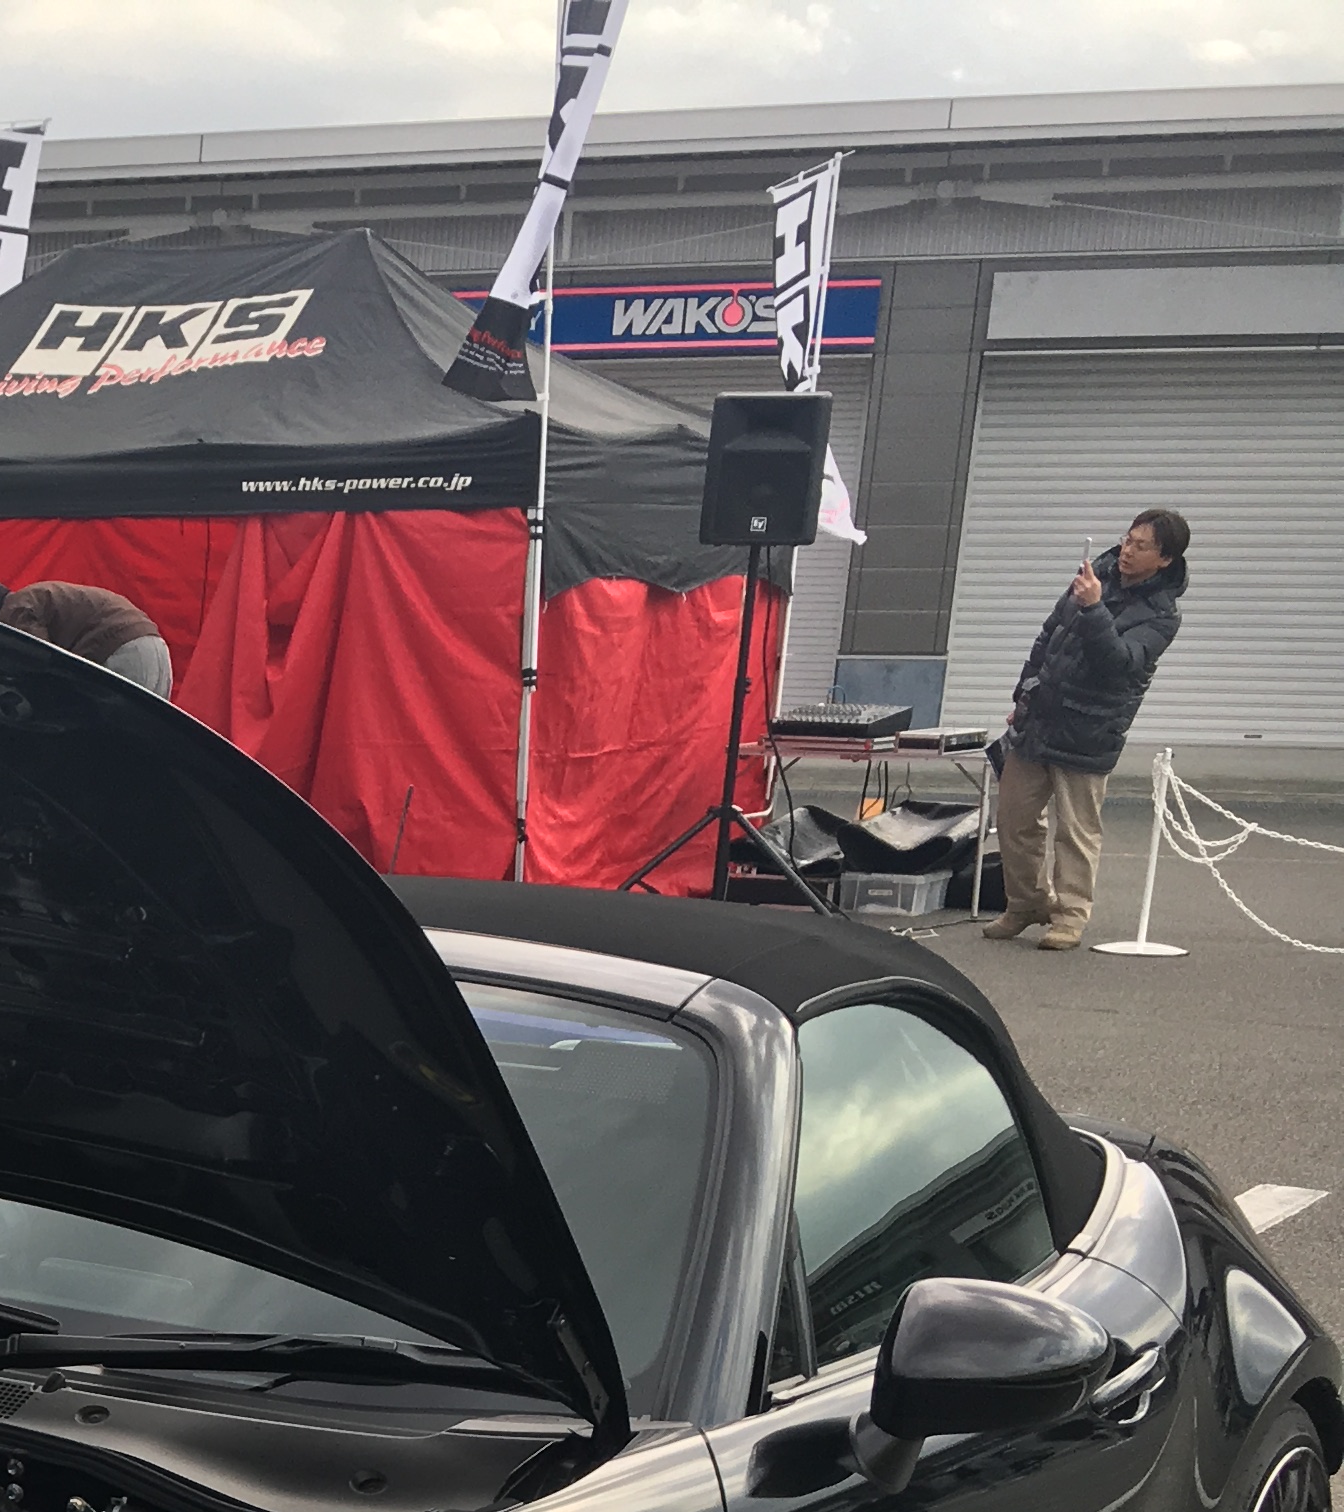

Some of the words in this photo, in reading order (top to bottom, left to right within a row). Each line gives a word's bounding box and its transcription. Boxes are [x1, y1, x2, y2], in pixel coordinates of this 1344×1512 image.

[26, 292, 308, 362] HKS
[612, 295, 779, 337] WAKO'S
[87, 335, 328, 395] Performance
[241, 473, 473, 494] www.hks-power.co.jp
